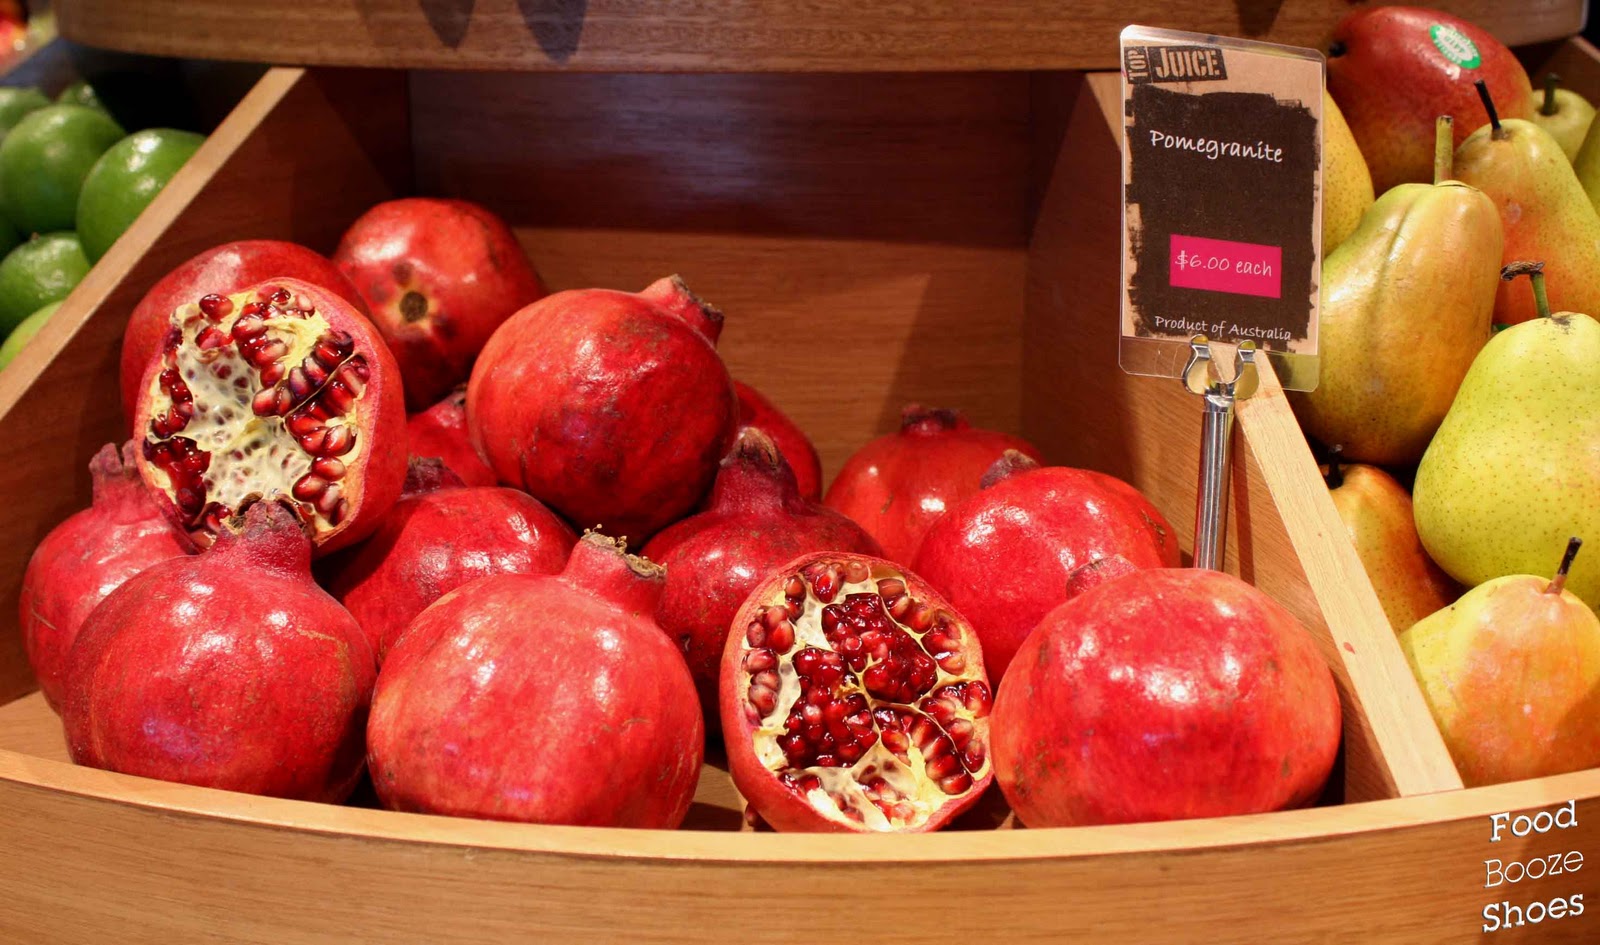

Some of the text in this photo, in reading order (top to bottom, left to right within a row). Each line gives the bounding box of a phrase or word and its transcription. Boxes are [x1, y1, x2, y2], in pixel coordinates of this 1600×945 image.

[1127, 49, 1148, 80] TOP
[1150, 129, 1283, 163] Pomegranite
[1175, 250, 1272, 277] $6.00 each
[1155, 315, 1292, 341] Product of Australia
